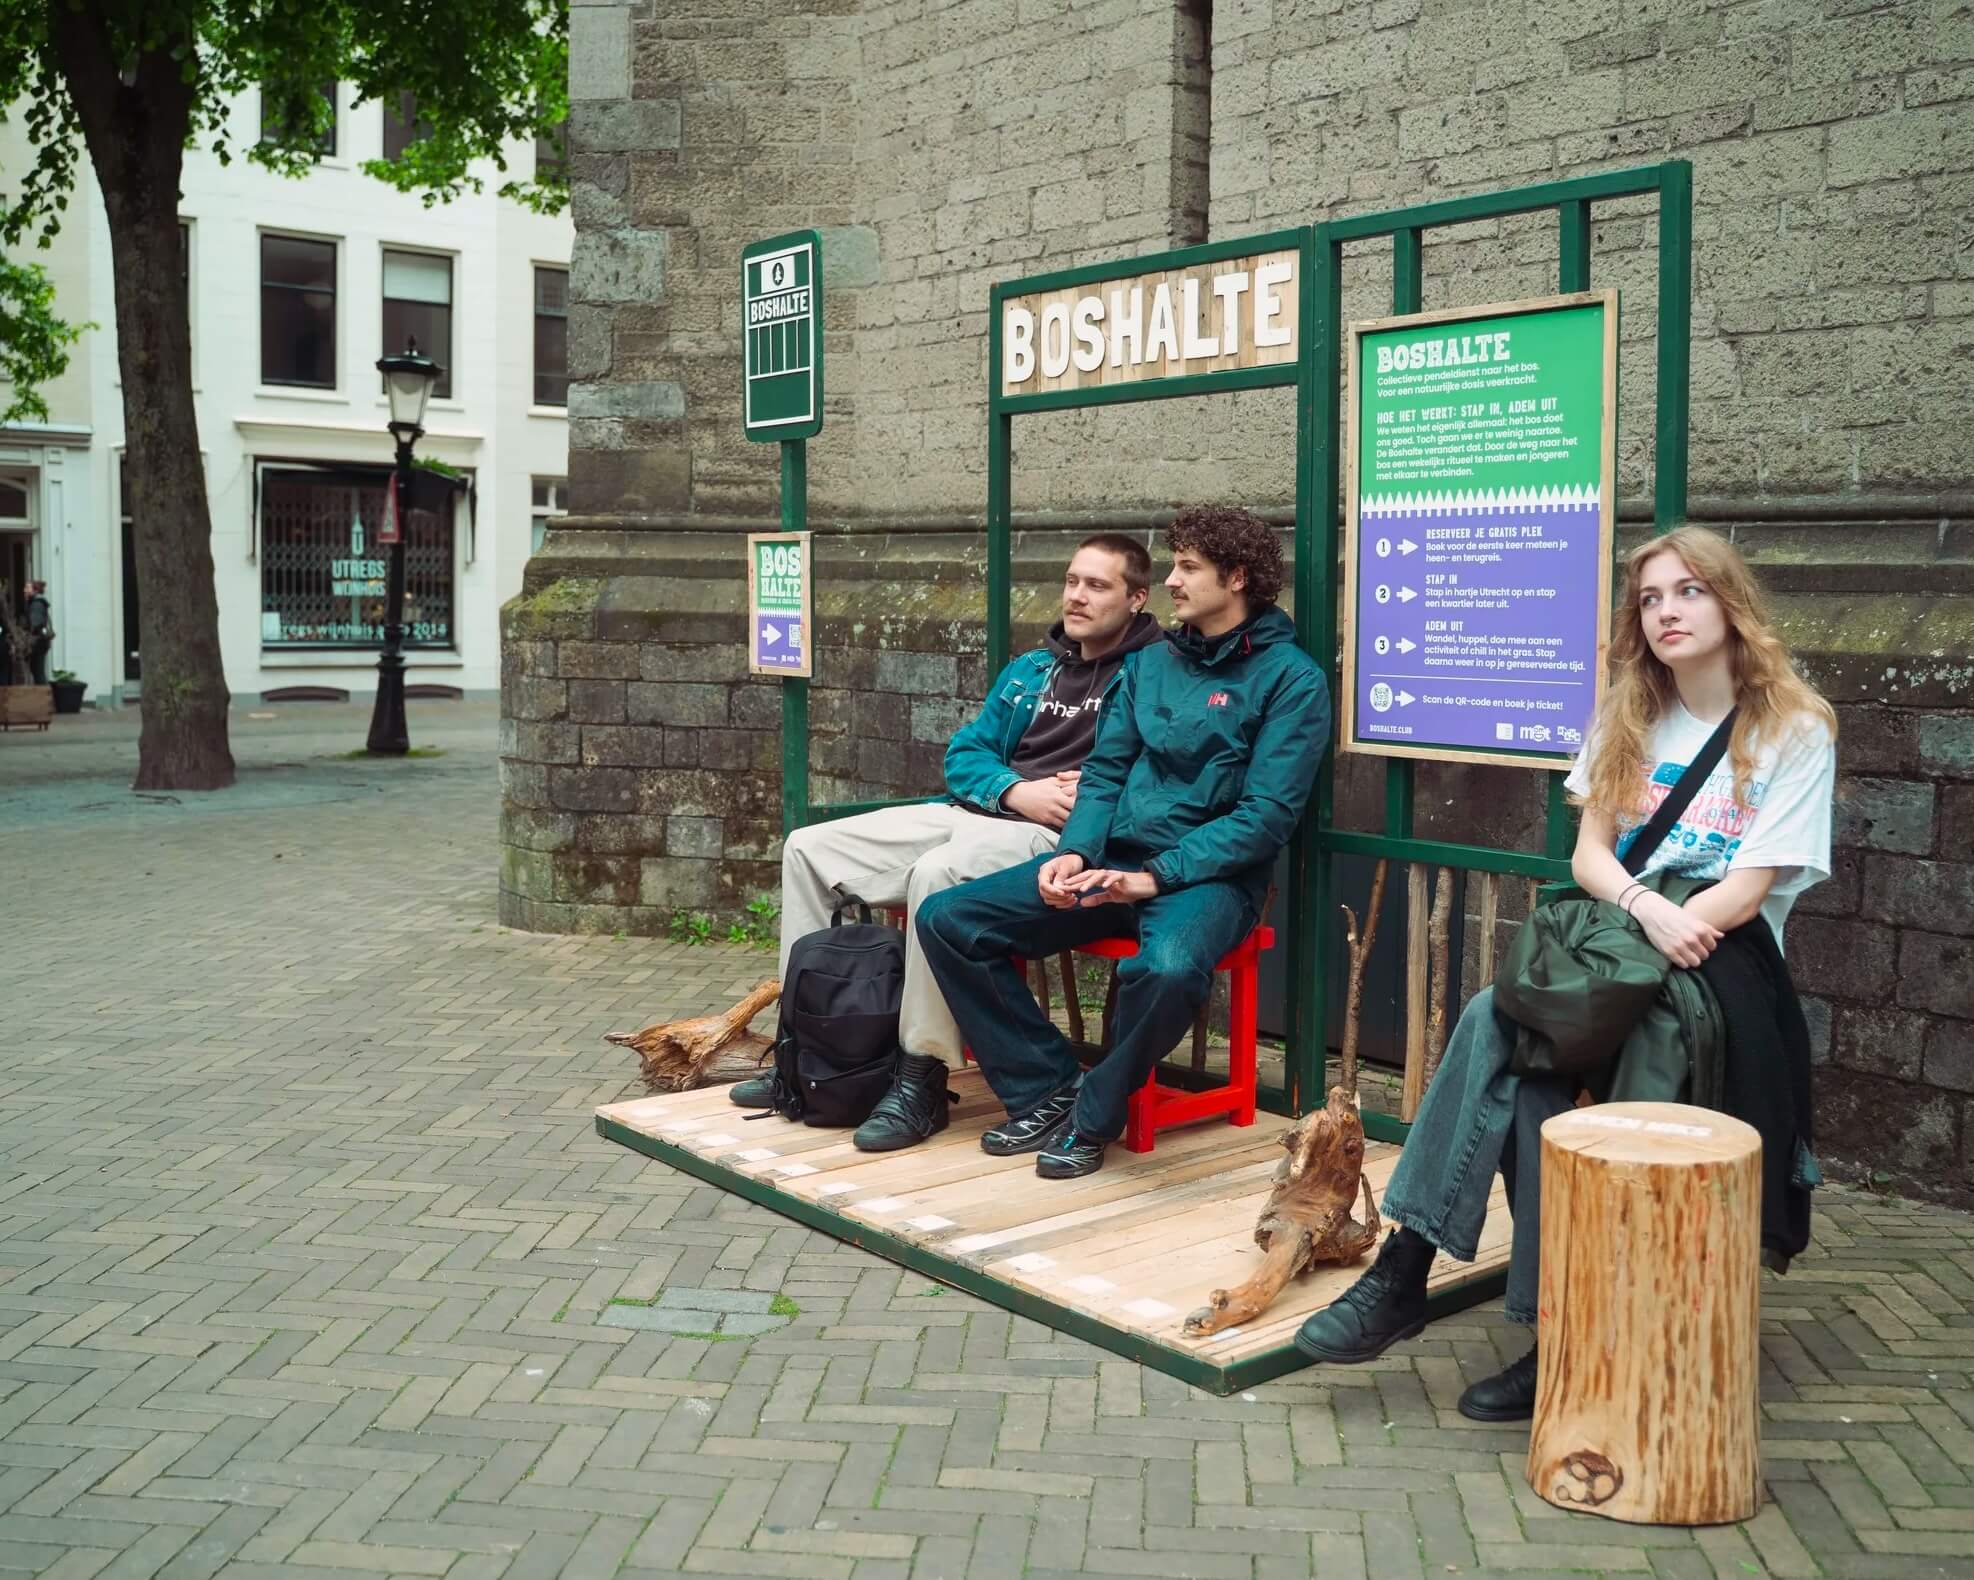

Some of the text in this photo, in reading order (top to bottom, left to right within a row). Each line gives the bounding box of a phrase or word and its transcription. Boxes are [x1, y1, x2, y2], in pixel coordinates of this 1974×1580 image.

[751, 291, 808, 322] BOSHALTE
[1007, 262, 1292, 384] BOSHALTE
[1376, 332, 1510, 373] BOSHALTE
[1377, 362, 1540, 386] Collectieve pendeldienst naar het bos.
[1377, 374, 1537, 397] Voor een natuurlijke dosis veerkracht.
[1377, 397, 1557, 424] HOE HET WERKT: STAP IN, ADEM UIT
[1377, 413, 1563, 435] We weten het eigenlijk allemaal: het bos doet
[1376, 439, 1391, 447] ons
[1392, 436, 1414, 448] goed.
[1416, 434, 1436, 444] Toch
[1437, 434, 1459, 445] gaan
[1474, 432, 1483, 440] er
[1485, 431, 1494, 439] te
[1495, 429, 1524, 440] weinig
[1525, 427, 1563, 437] naartoe.
[1376, 437, 1578, 458] De Boshalte verandert dat. Door de weg naar het
[1376, 450, 1569, 469] bos een wekelijks ritueel te maken en jongeren
[1376, 467, 1474, 480] met elkaar te verbinden.
[1426, 526, 1543, 539] RESERVEER JE GRATIS PLEK
[1381, 541, 1386, 553] 1
[1426, 539, 1568, 551] Boek voor de eerste keer meteen je
[760, 546, 800, 577] BOS
[1426, 554, 1450, 562] heen-
[1464, 552, 1503, 564] terugreis.
[332, 560, 385, 578] UTREGS
[760, 578, 800, 597] HALTE
[1425, 574, 1458, 585] STAP IN
[1380, 588, 1386, 598] 2
[1425, 588, 1443, 598] Stap
[1445, 587, 1453, 596] in
[1454, 587, 1478, 598] hartje
[1480, 587, 1510, 596] Utrecht
[1511, 589, 1522, 599] op
[1536, 589, 1556, 599] stap
[1425, 599, 1510, 608] een kwartier later uit.
[414, 622, 447, 636] 2014
[1425, 620, 1464, 631] ADEM UIT
[1380, 639, 1385, 650] 3
[1425, 634, 1563, 646] Wandel, huppel, doe mee aan een
[1424, 645, 1556, 660] activiteit of chill in het gras. Stap
[1424, 656, 1586, 673] daarna weer in op je gereserveerde tijd.
[1423, 694, 1563, 711] Scan de QR-code en boek je ticket!
